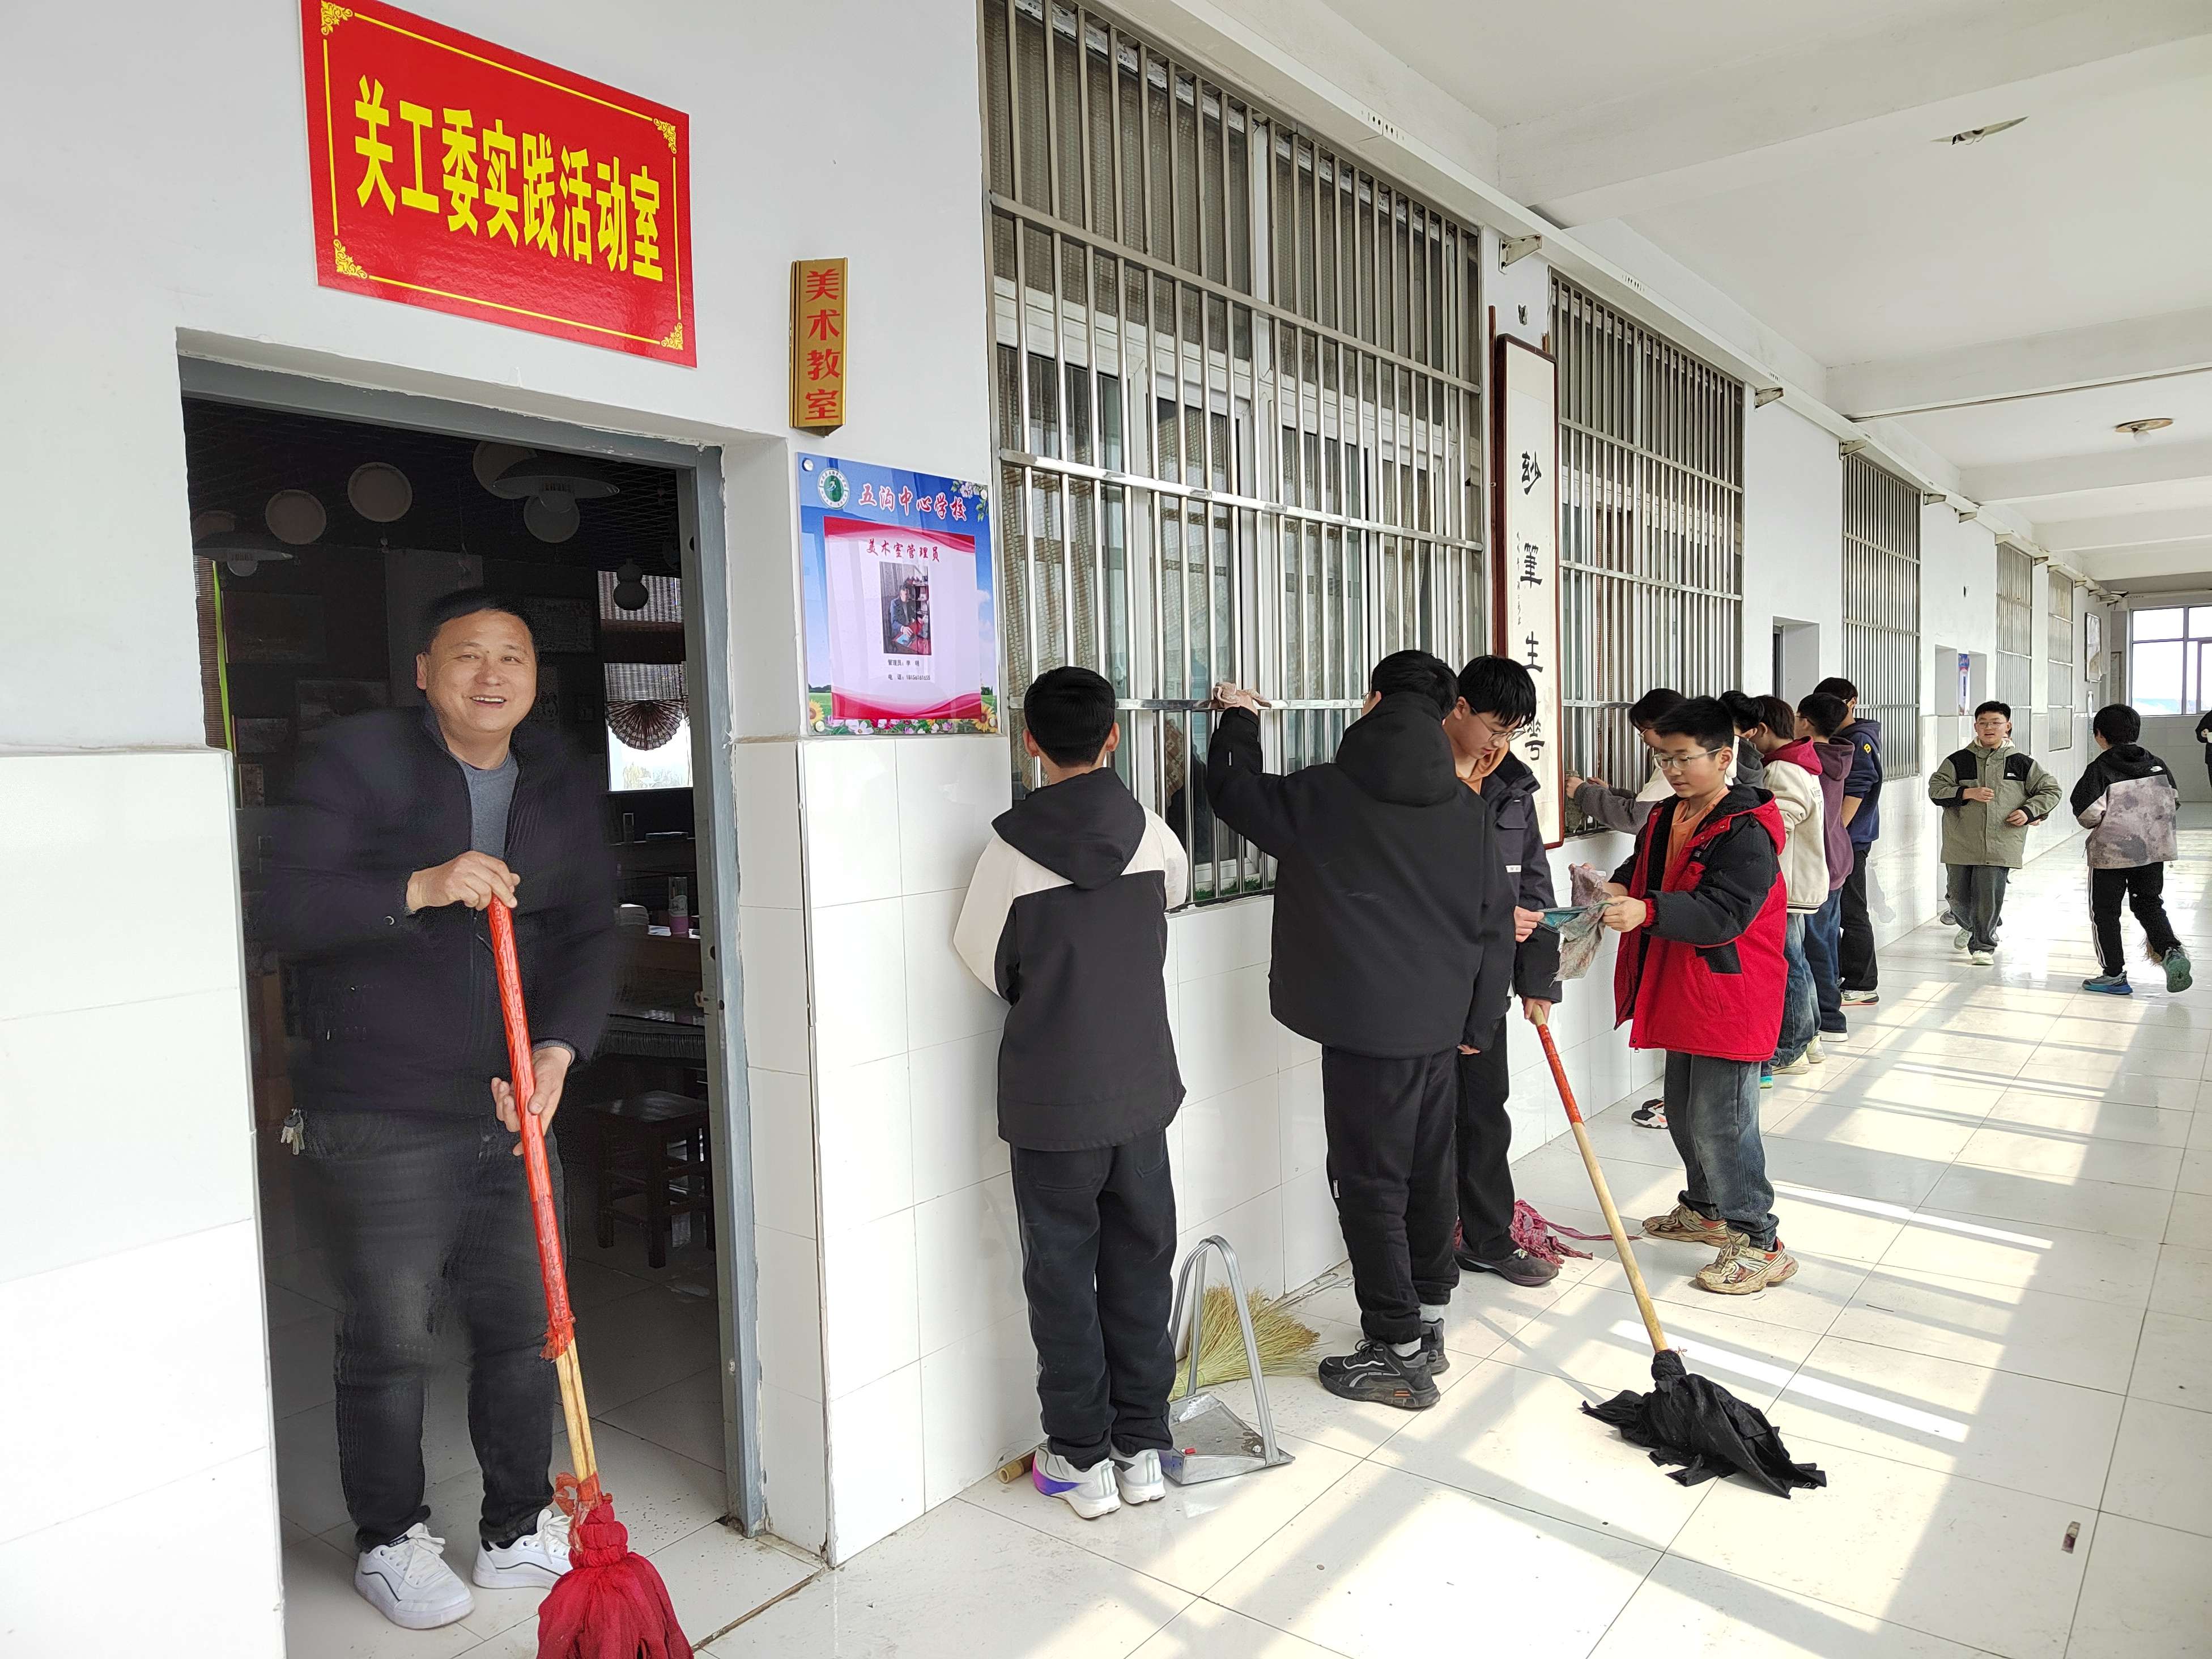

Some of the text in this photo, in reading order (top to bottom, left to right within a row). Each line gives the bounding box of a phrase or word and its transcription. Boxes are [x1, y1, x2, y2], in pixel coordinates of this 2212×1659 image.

[354, 74, 663, 282] 关工委实践活动室
[805, 268, 841, 420] 美术教室
[858, 483, 967, 522] 五沟中心学校
[866, 538, 940, 563] 美术室管理员
